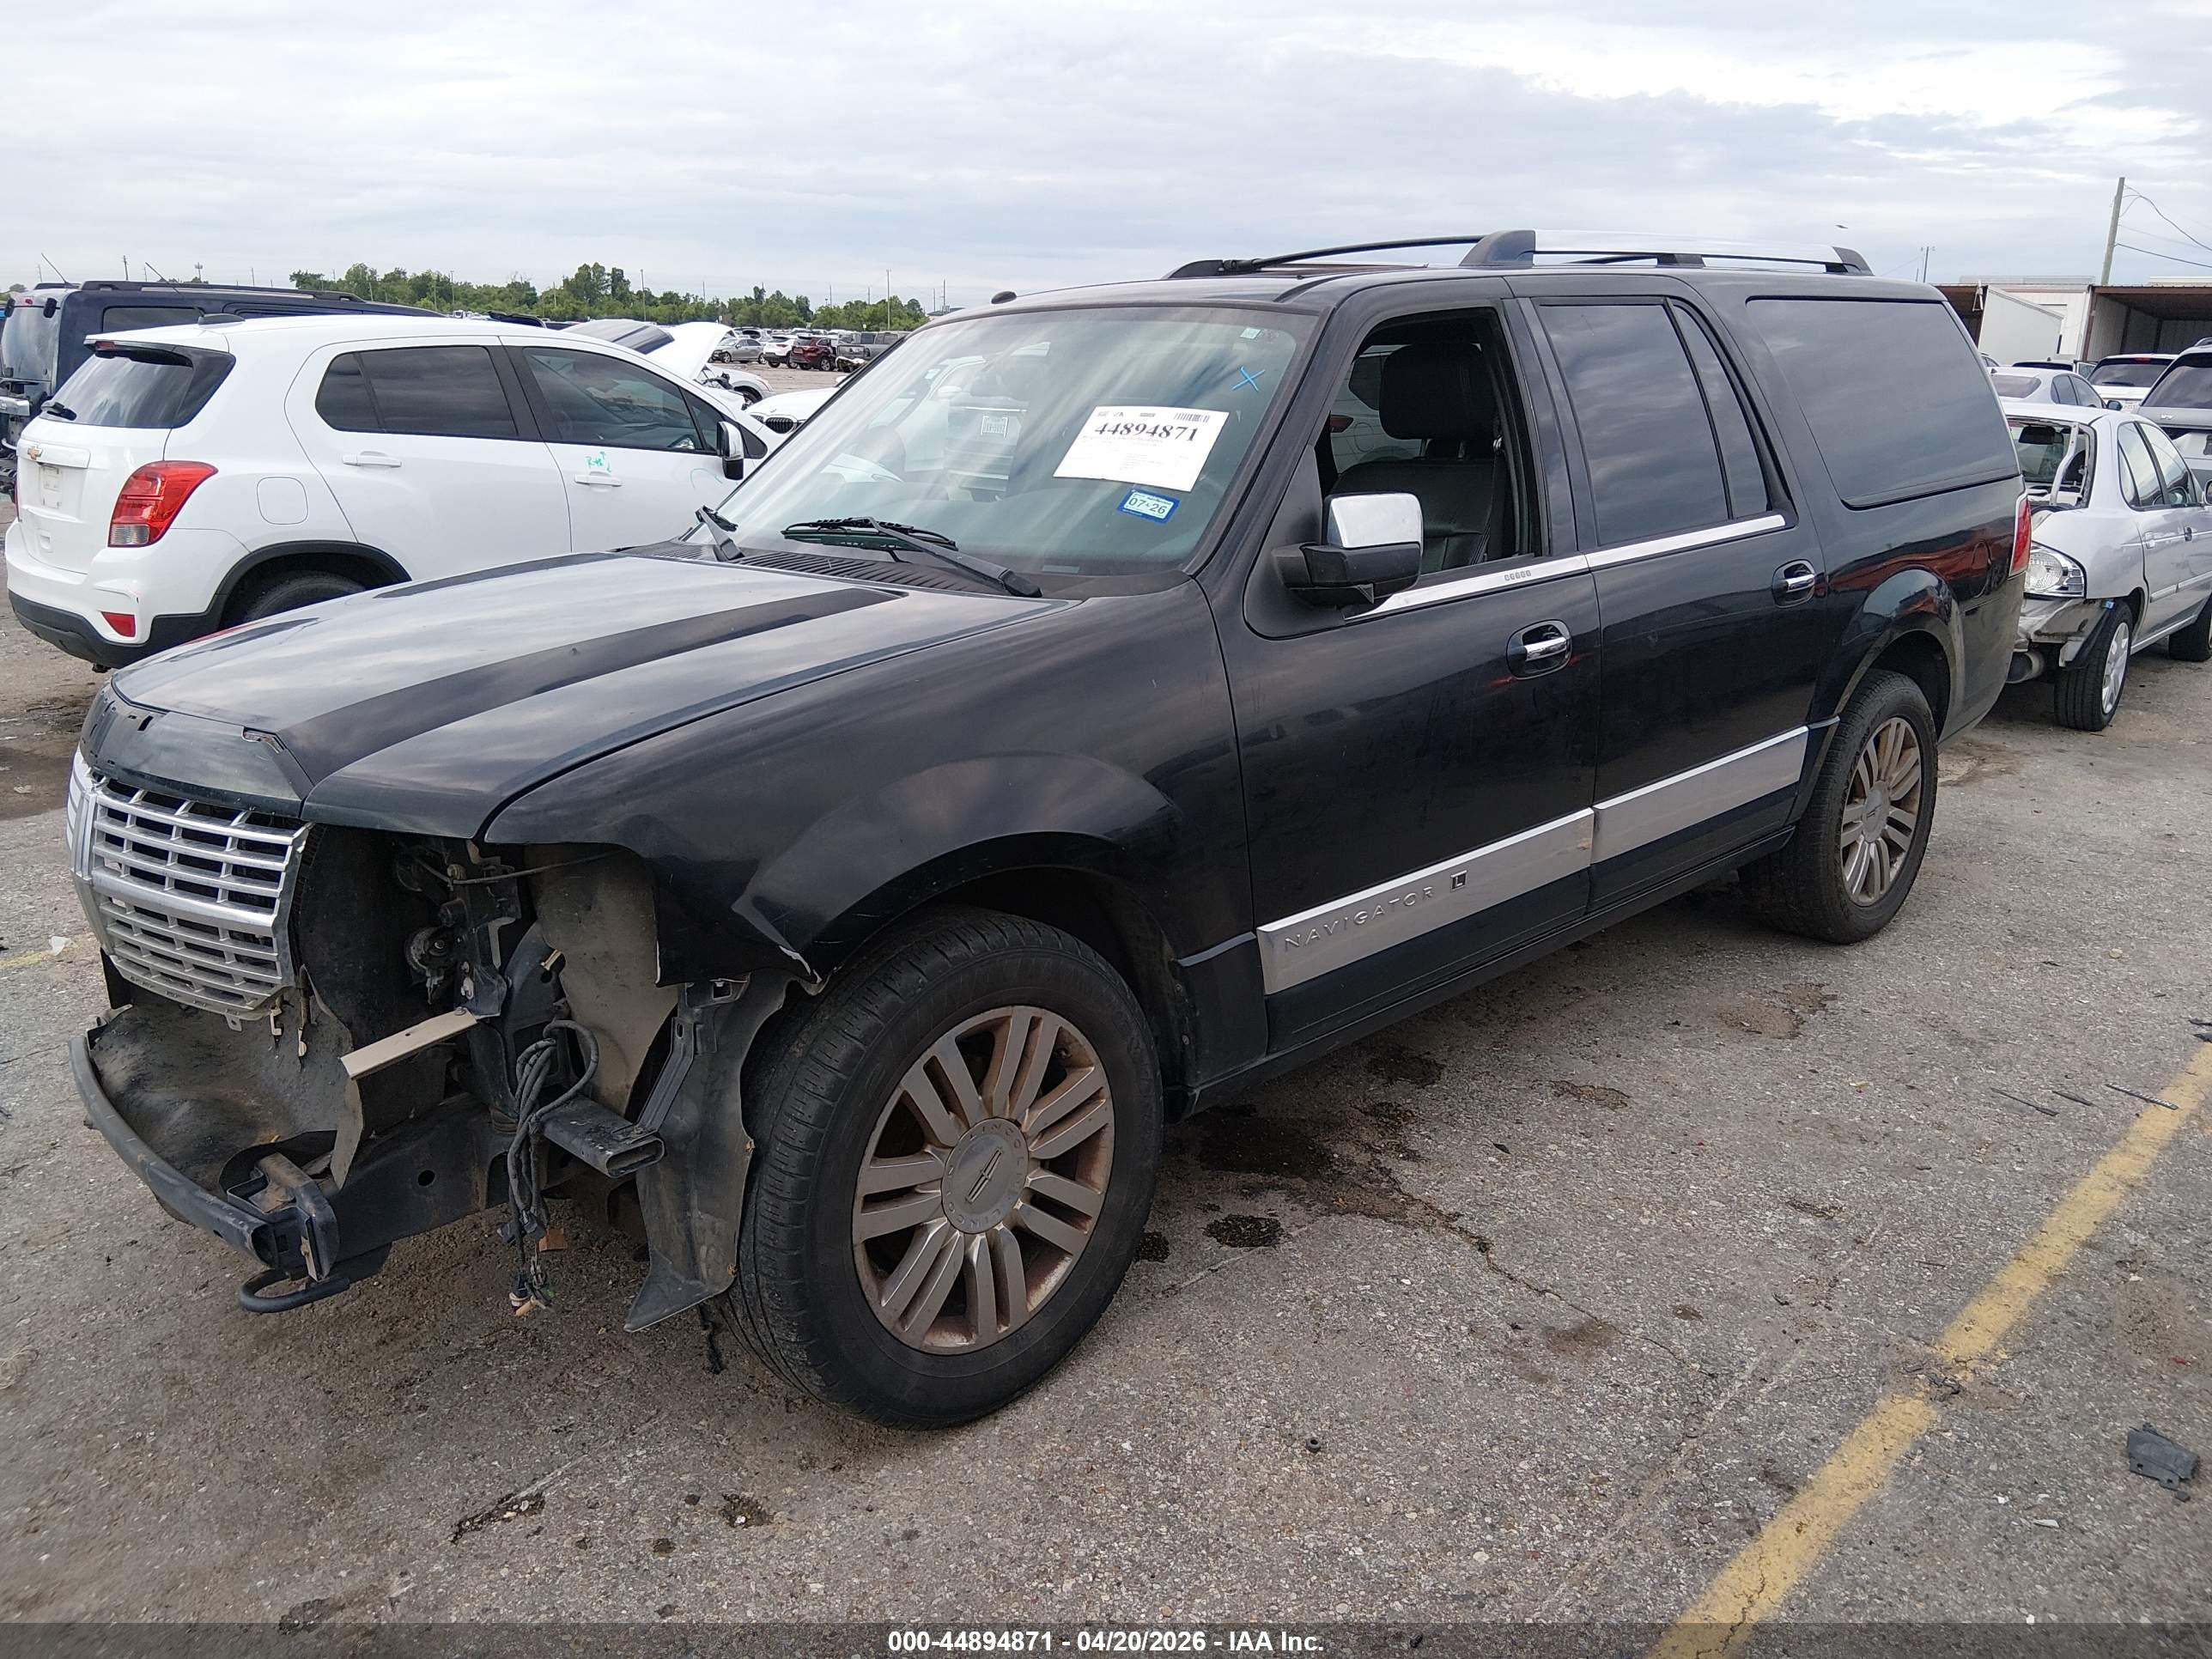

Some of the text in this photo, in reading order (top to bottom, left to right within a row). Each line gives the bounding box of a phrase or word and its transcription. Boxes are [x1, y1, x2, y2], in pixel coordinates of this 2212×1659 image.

[1095, 422, 1198, 441] 44894871
[1128, 498, 1146, 508] 07
[1149, 503, 1168, 514] 26
[1285, 886, 1433, 952] NAVIGATOR
